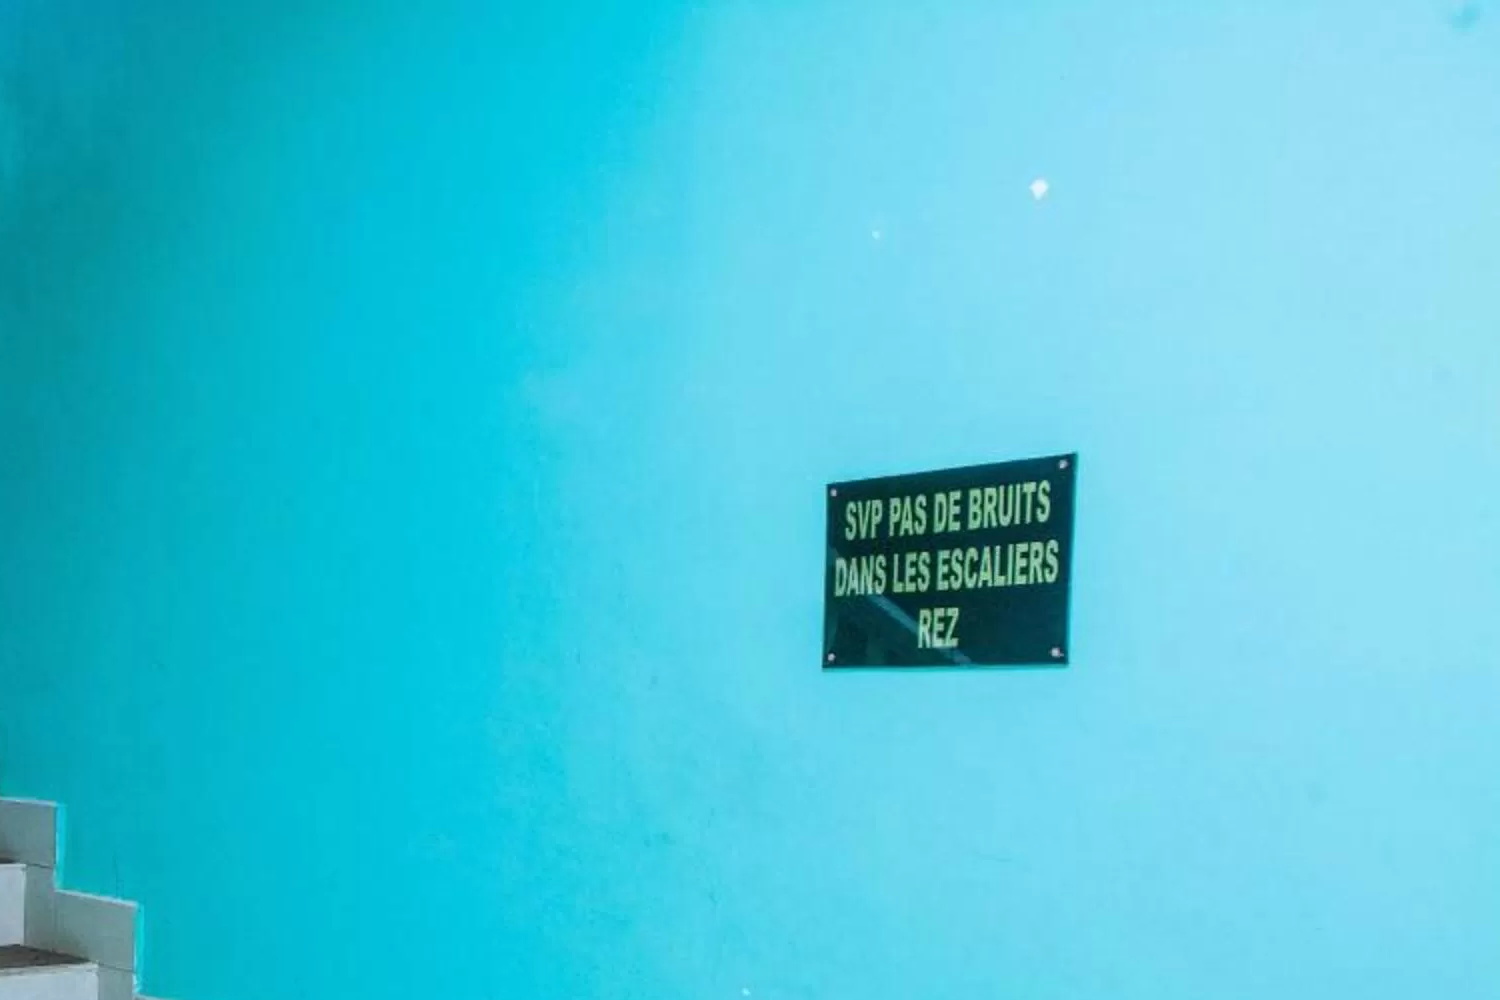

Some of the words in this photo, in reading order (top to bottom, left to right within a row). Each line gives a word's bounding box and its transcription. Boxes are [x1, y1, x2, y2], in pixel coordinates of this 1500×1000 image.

[845, 499, 883, 541] SVP
[889, 494, 927, 537] PAS
[933, 490, 962, 533] DE
[968, 479, 1051, 531] BRUITS
[834, 554, 887, 597] DANS
[892, 550, 931, 593] LES
[936, 539, 1059, 591] ESCALIERS
[917, 607, 960, 649] REZ
